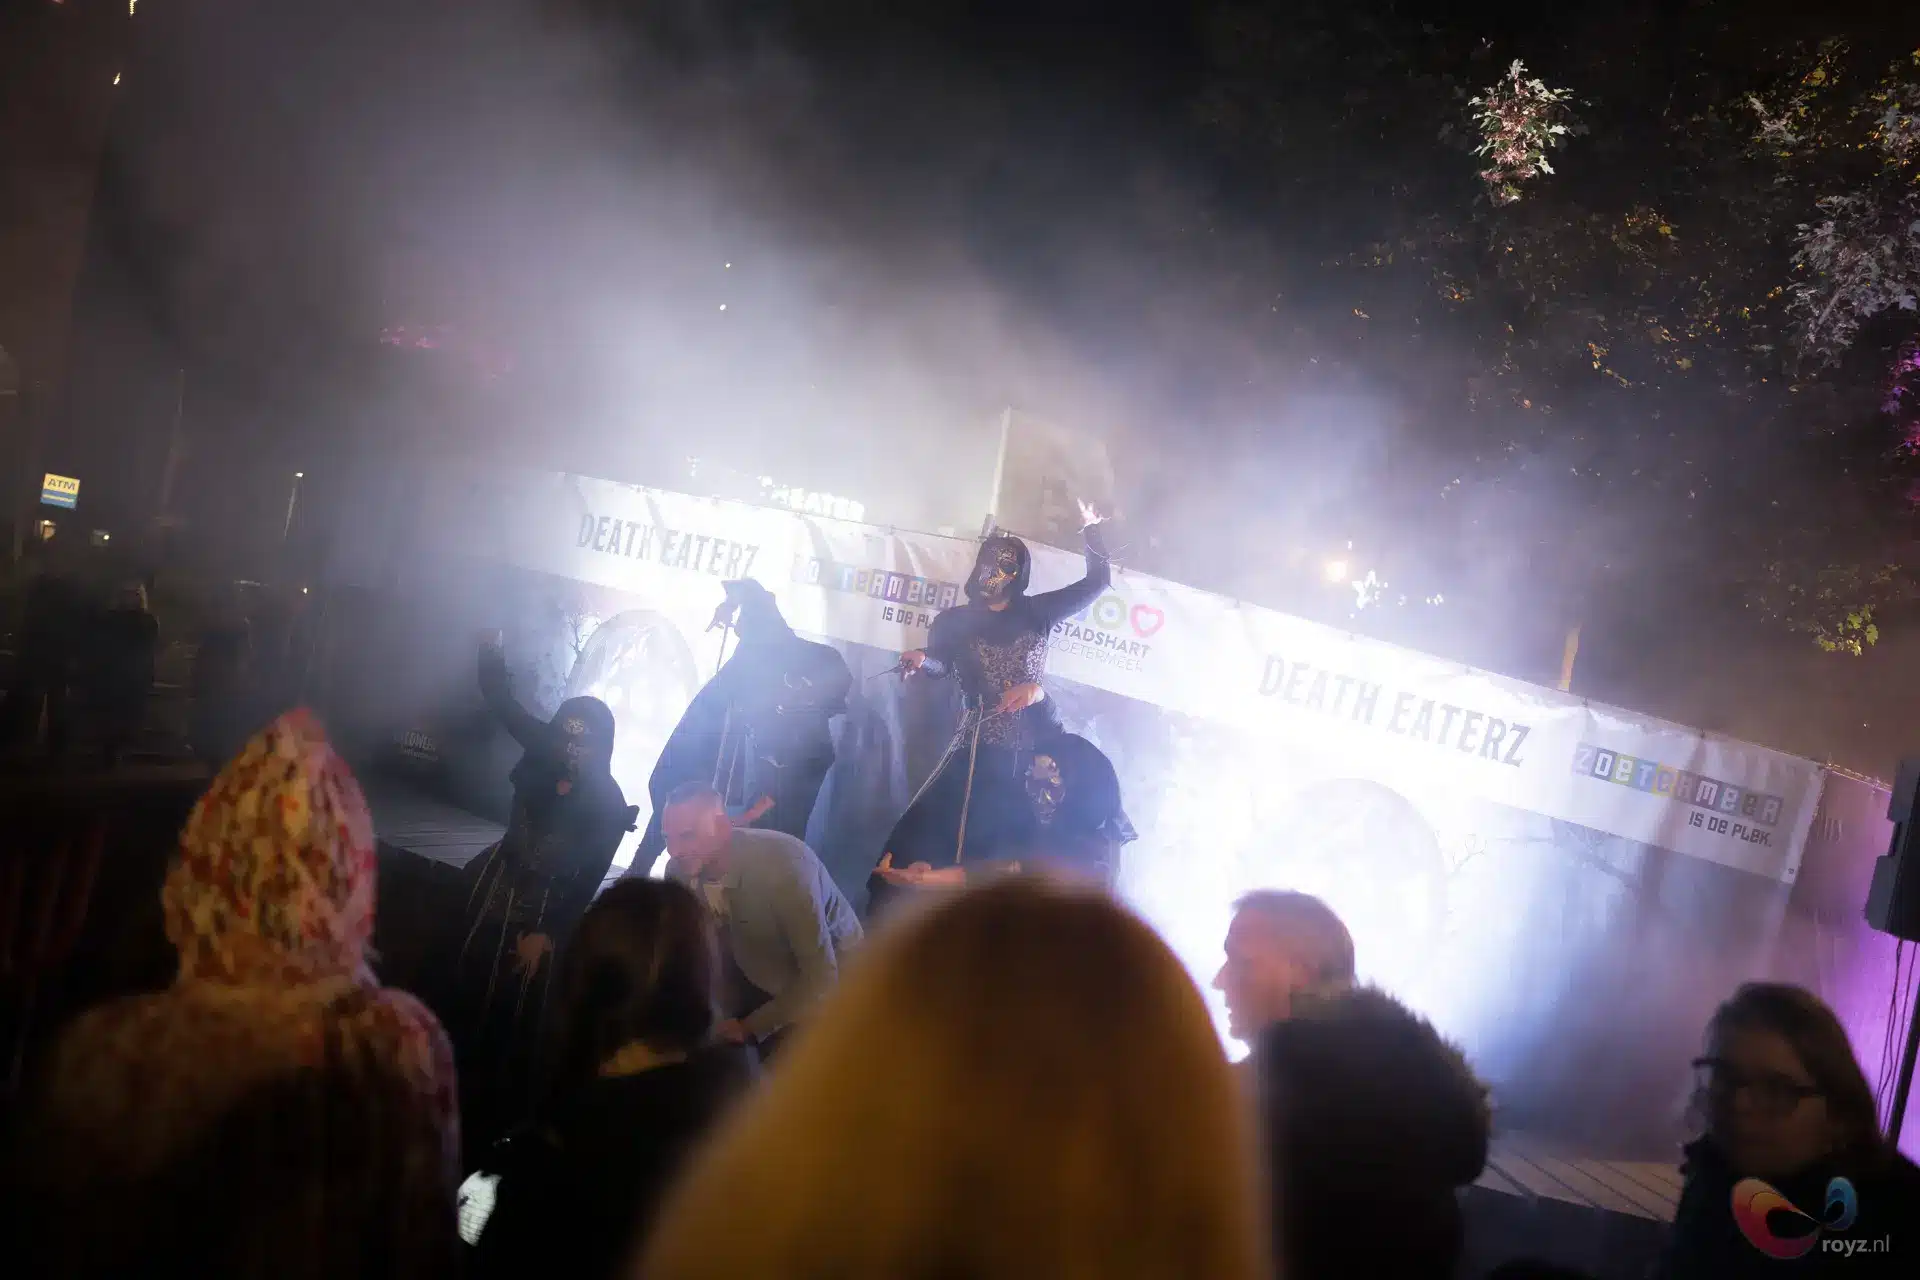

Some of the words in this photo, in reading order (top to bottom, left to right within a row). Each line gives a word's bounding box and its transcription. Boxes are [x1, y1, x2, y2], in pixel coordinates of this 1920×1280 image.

[47, 478, 76, 491] ATM
[576, 513, 657, 561] DEATH
[659, 528, 761, 580] EATERZ
[882, 606, 894, 622] IS
[1049, 635, 1143, 673] ZOETERMEER
[1052, 620, 1153, 659] STADSHART
[1258, 652, 1383, 726] DEATH
[1386, 690, 1532, 768] EATERZ
[1688, 810, 1704, 828] IS
